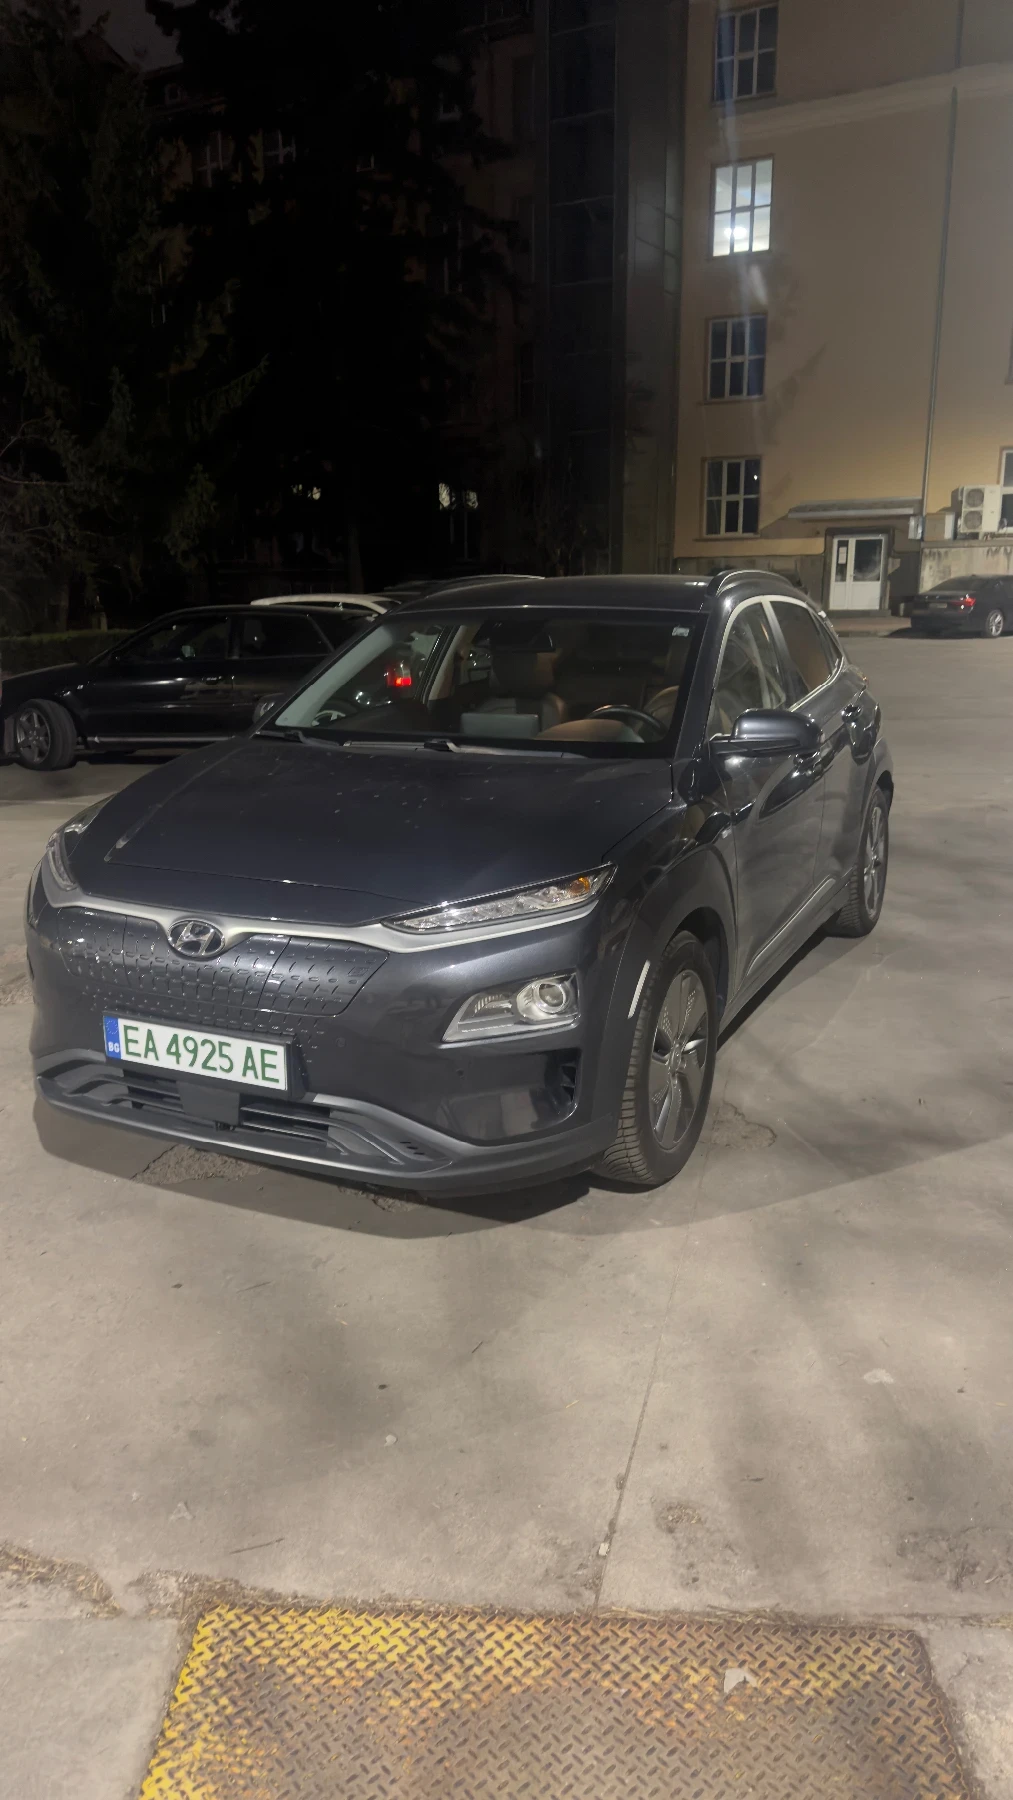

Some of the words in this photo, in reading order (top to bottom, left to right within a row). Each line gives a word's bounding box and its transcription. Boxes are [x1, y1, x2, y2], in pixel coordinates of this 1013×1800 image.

[108, 1041, 120, 1053] BG
[123, 1024, 160, 1061] EA
[166, 1033, 234, 1074] 4925
[242, 1046, 280, 1083] AE
